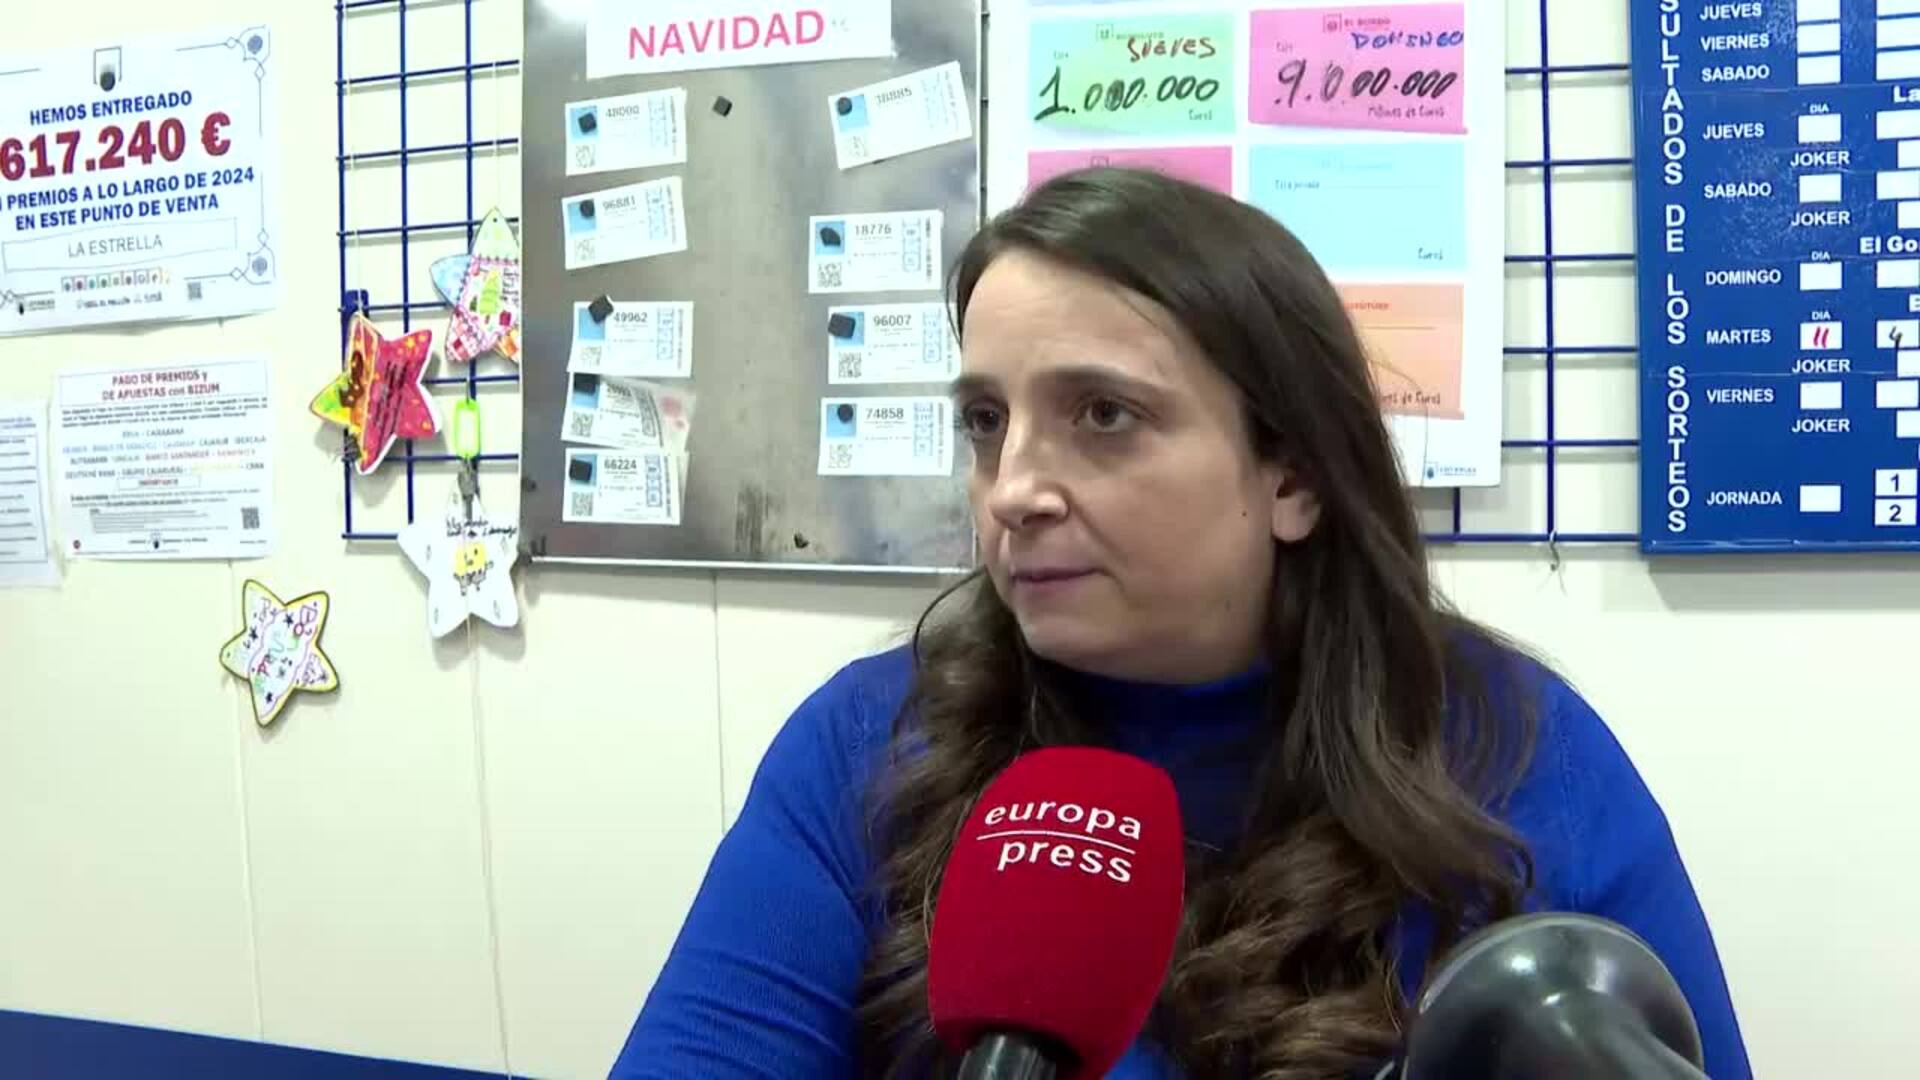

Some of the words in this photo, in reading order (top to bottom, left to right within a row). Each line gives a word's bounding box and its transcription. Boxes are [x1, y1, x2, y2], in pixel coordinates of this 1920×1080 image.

[1700, 2, 1762, 20] JUEVES
[628, 8, 825, 60] NAVIDAD
[1701, 33, 1770, 51] VIERNES
[1702, 65, 1771, 83] SABADO
[29, 104, 87, 126] HEMOS
[92, 90, 192, 118] ENTREGADO
[1810, 103, 1829, 114] DIA
[1703, 122, 1765, 140] JUEVES
[0, 117, 186, 181] 617.240
[201, 111, 231, 156] €
[1790, 151, 1850, 167] JOKER
[7, 187, 78, 210] PREMIOS
[83, 185, 93, 202] A
[98, 182, 118, 200] LO
[123, 175, 180, 197] LARGO
[184, 172, 207, 190] DE
[212, 166, 254, 187] 2024
[1704, 182, 1772, 199] SABADO
[16, 214, 36, 231] EN
[40, 209, 77, 228] ESTE
[81, 203, 134, 224] PUNTO
[139, 200, 161, 217] DE
[166, 193, 219, 214] VENTA
[1791, 210, 1851, 227] JOKER
[1665, 204, 1686, 253] DE
[68, 242, 85, 258] LA
[88, 234, 163, 255] ESTRELLA
[1860, 236, 1881, 254] El
[1811, 250, 1830, 261] DIA
[1705, 269, 1782, 286] DOMINGO
[1667, 274, 1690, 345] LOS
[1812, 310, 1831, 321] DIA
[872, 313, 912, 327] 96007
[1706, 328, 1772, 345] MARTES
[1792, 359, 1851, 374] JOKER
[1706, 388, 1774, 404] VIERNES
[864, 407, 905, 421] 74858
[1791, 418, 1850, 433] JOKER
[1667, 366, 1691, 533] SORTEOS
[1890, 474, 1900, 493] 1
[1706, 490, 1783, 506] JORNADA
[1888, 504, 1902, 523] 2
[984, 800, 1141, 840] europa
[997, 841, 1133, 883] press
